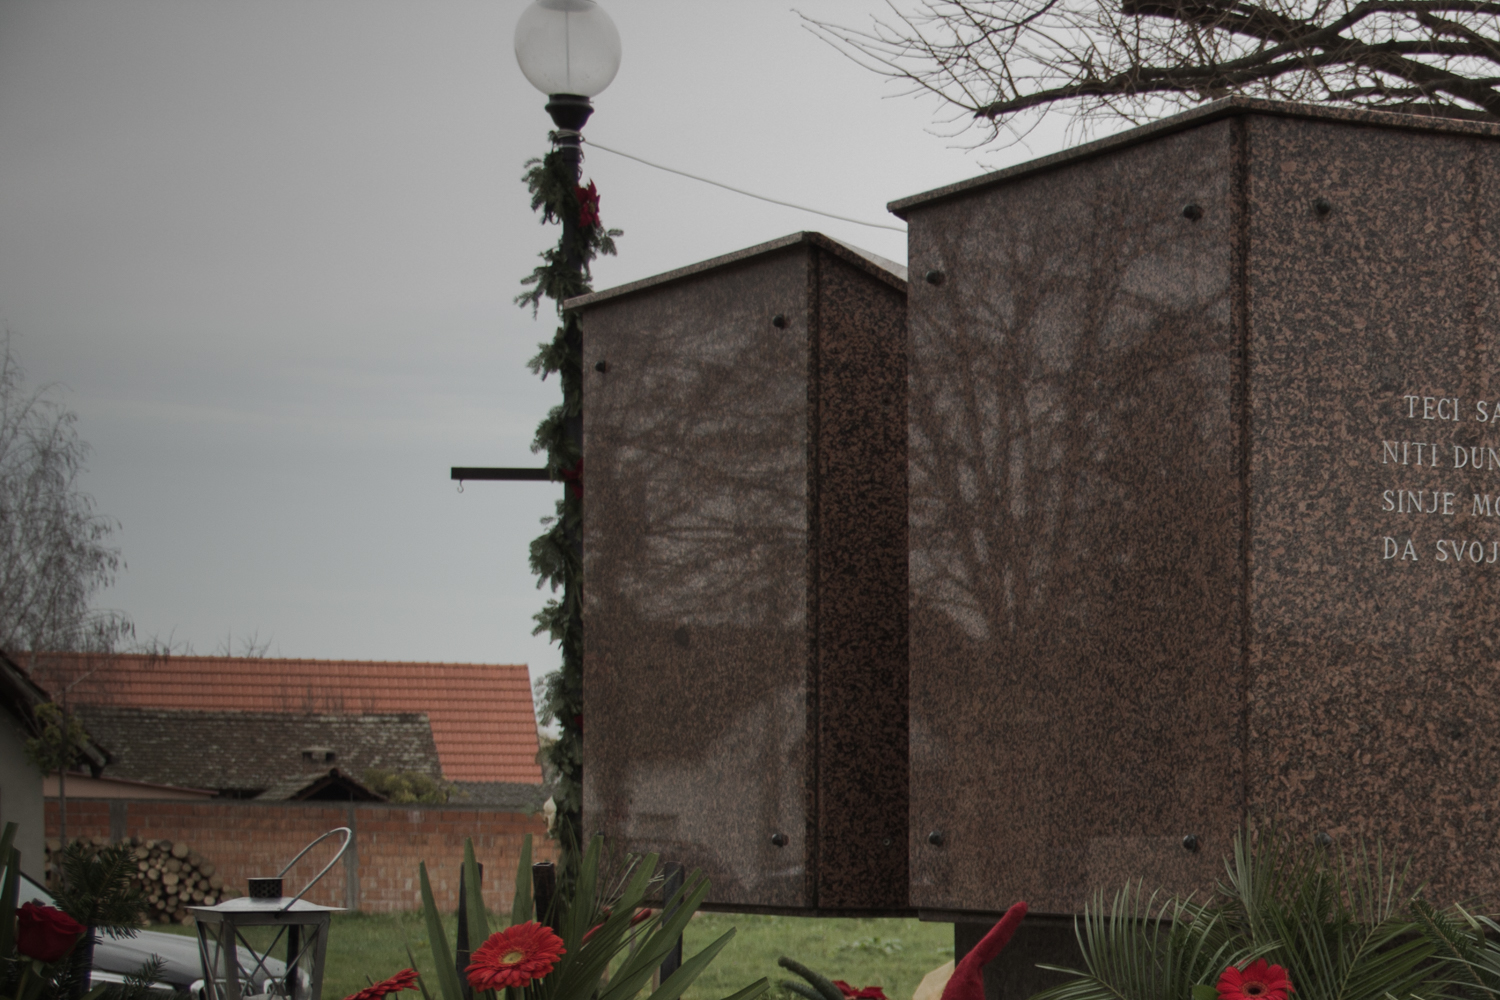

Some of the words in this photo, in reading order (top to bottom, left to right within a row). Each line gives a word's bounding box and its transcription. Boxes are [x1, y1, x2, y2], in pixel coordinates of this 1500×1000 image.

[1402, 395, 1460, 422] TECI
[1382, 440, 1439, 467] NITI
[1382, 490, 1455, 516] SINJE
[1383, 536, 1418, 562] DA
[1435, 539, 1499, 564] SVOJ
